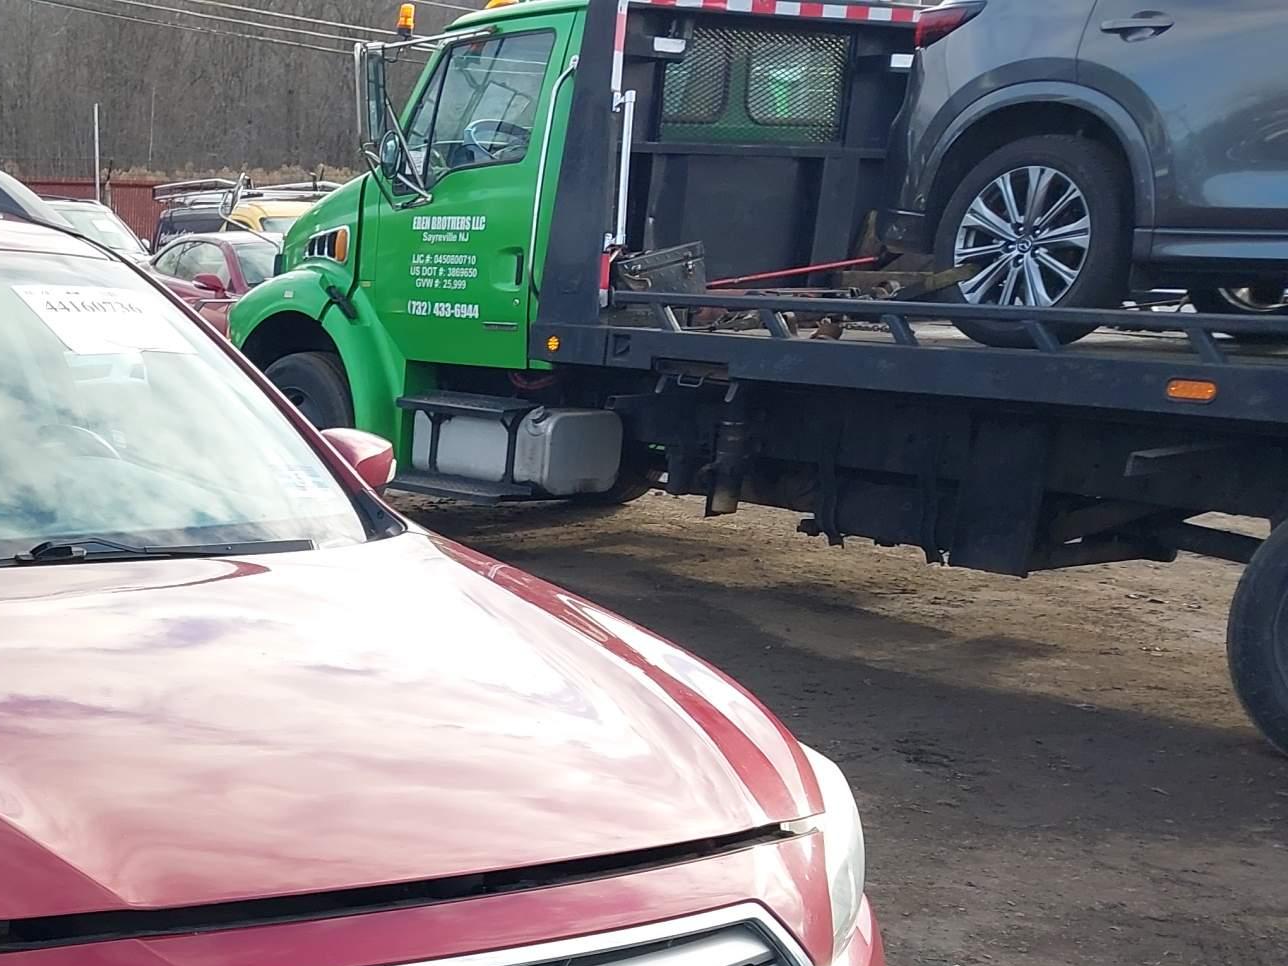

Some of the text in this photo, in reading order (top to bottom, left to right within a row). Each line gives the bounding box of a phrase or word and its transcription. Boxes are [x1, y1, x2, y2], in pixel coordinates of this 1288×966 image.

[431, 216, 471, 230] BROTHERS
[472, 216, 485, 230] LLC
[423, 232, 469, 243] Sayreville NJ
[412, 254, 425, 264] LIC
[410, 266, 420, 276] US
[421, 266, 438, 276] DOT
[415, 278, 433, 288] GVW
[443, 280, 466, 289] 25,999
[408, 300, 479, 318] (732) 433-6944
